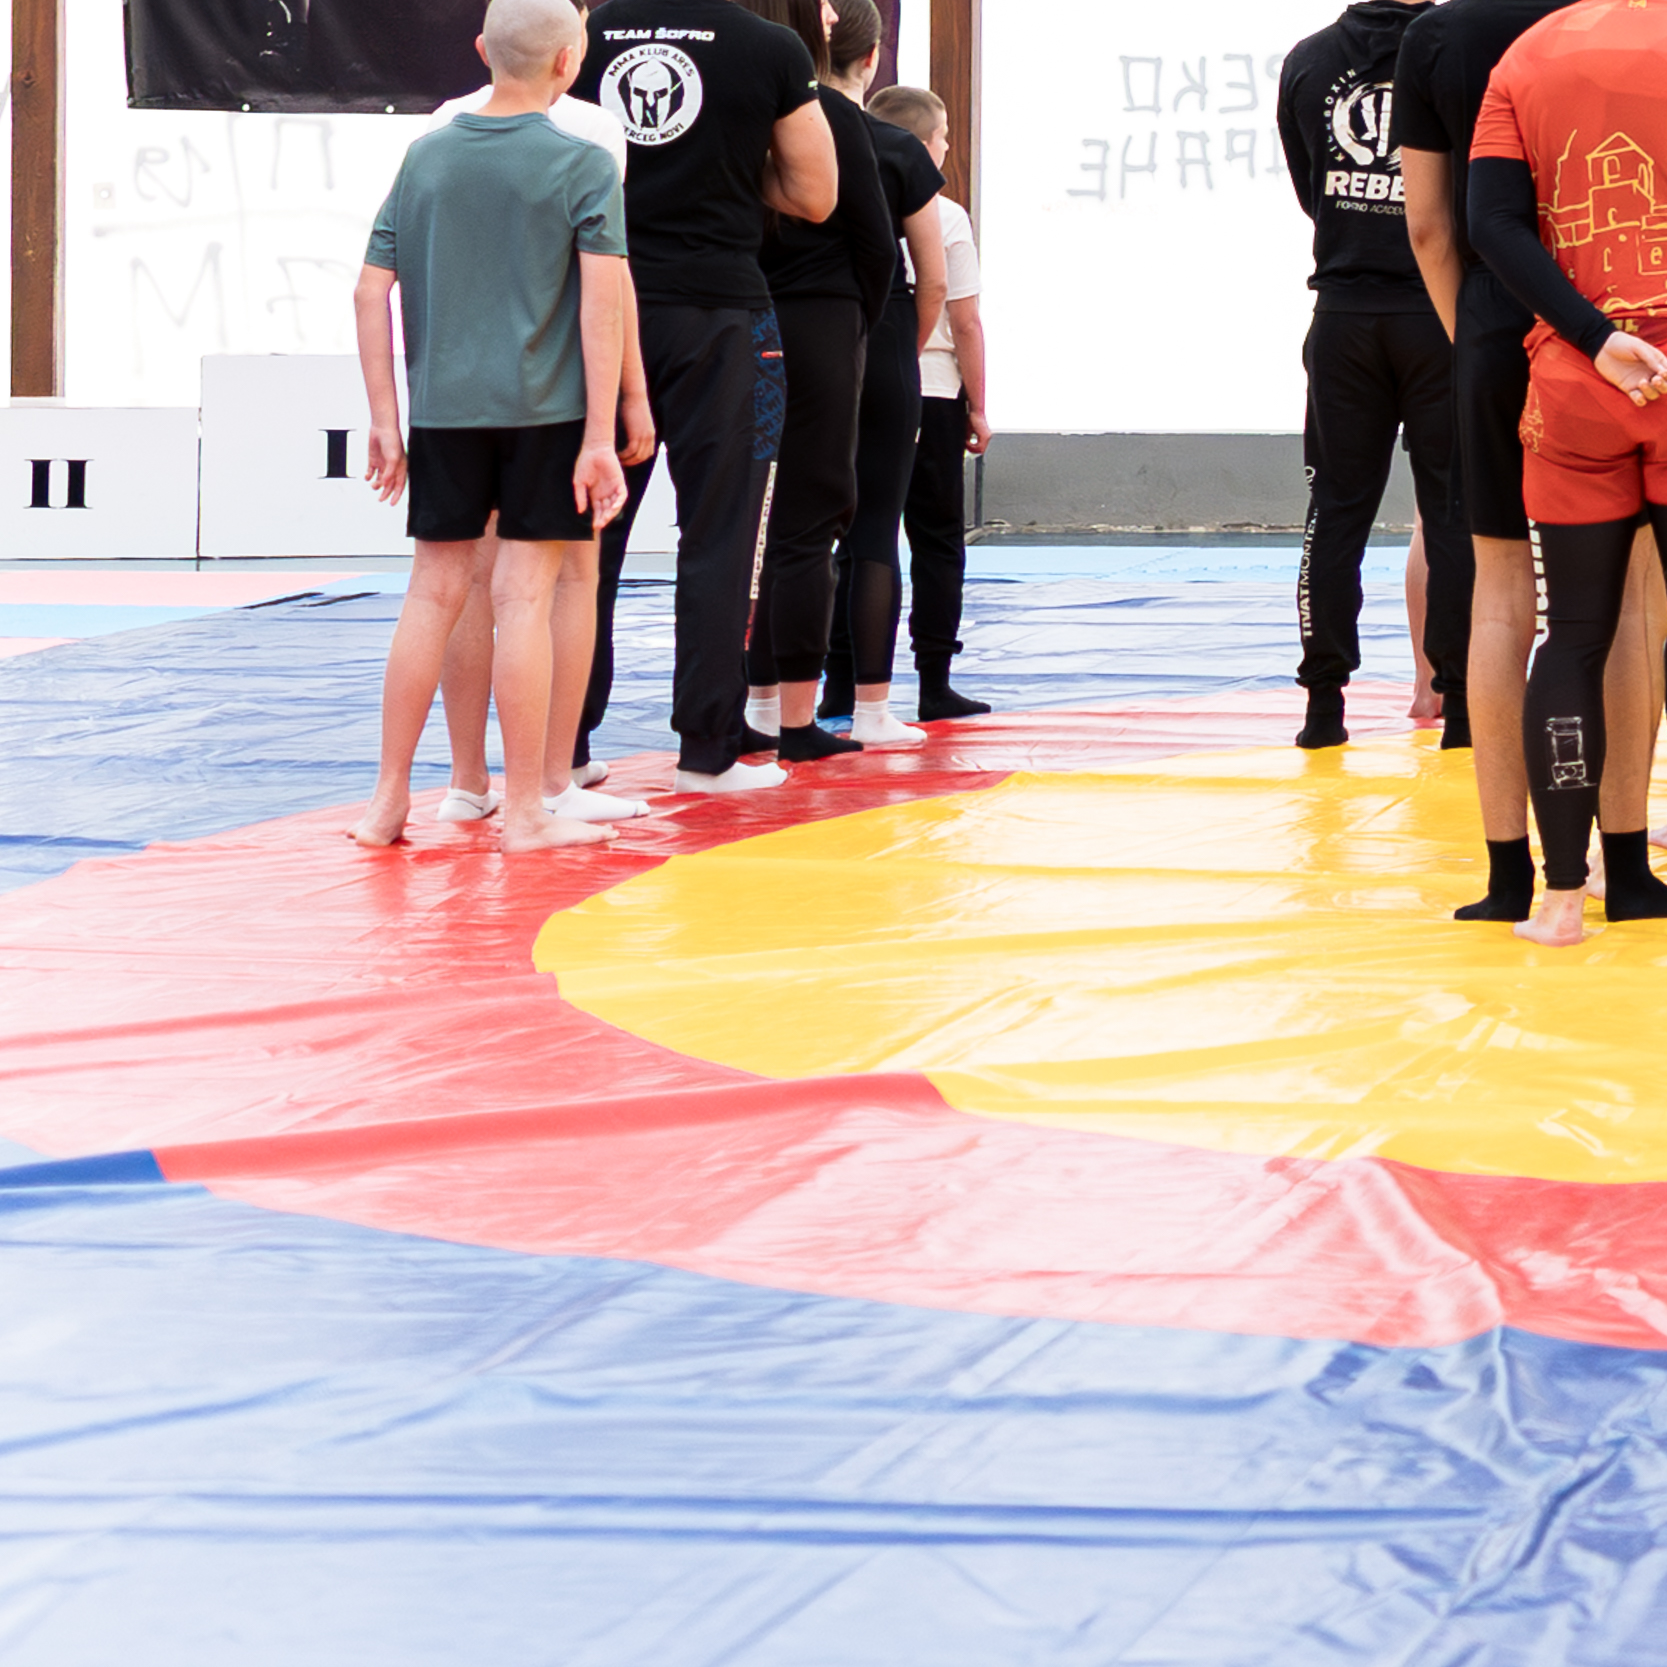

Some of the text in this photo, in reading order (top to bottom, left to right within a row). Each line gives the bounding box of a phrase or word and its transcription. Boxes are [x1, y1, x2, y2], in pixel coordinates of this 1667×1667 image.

[603, 29, 652, 41] TEAM
[608, 53, 636, 77] MMA
[639, 47, 669, 57] KLUB
[1325, 171, 1406, 202] REBE
[318, 429, 357, 479] I
[24, 458, 94, 510] II
